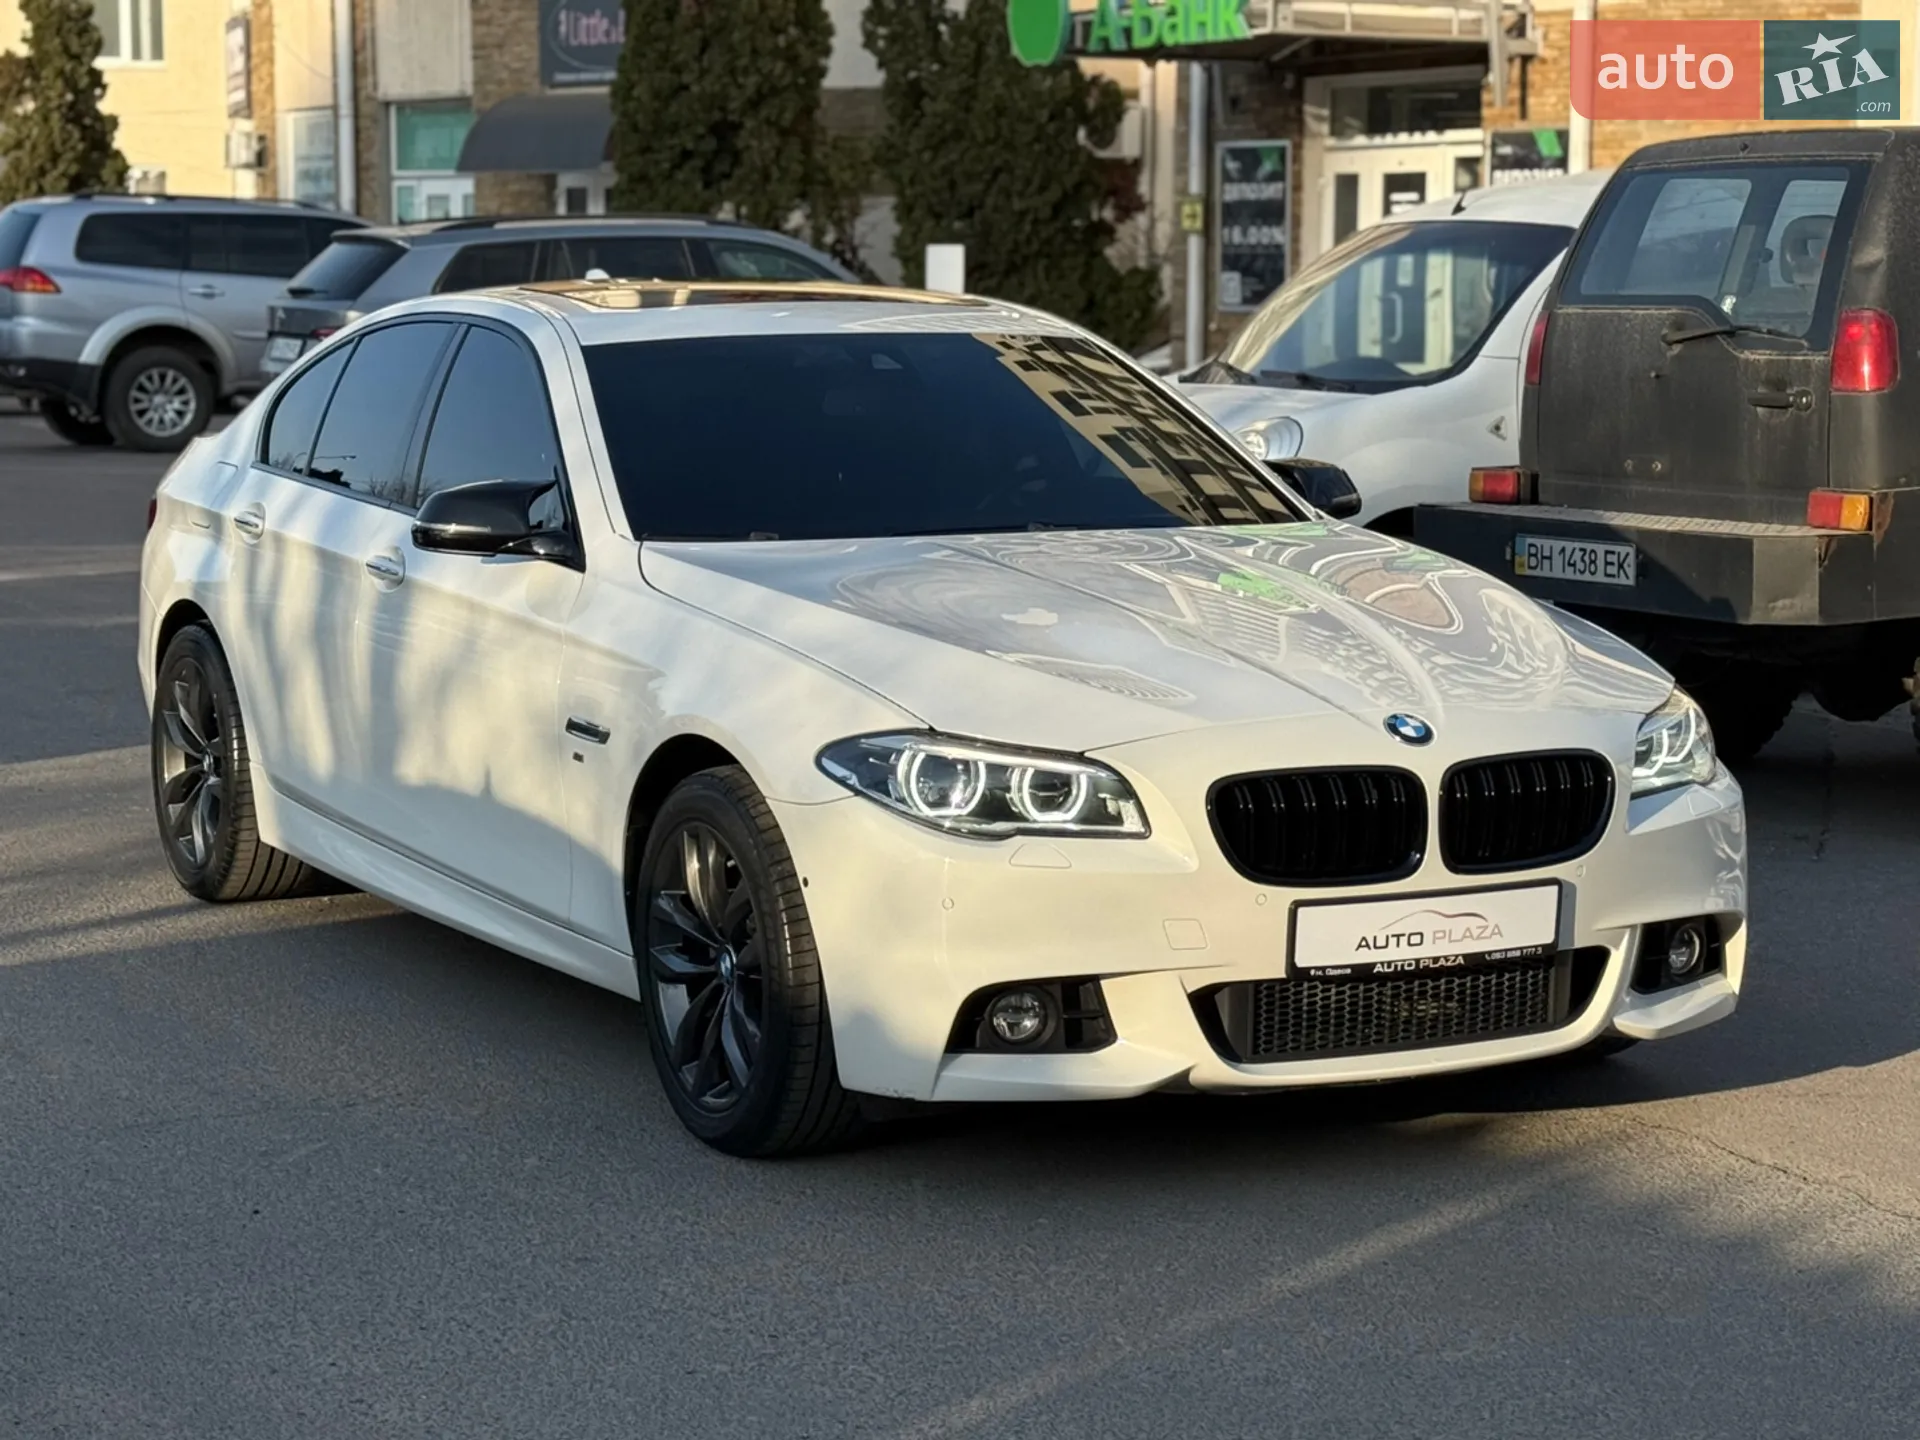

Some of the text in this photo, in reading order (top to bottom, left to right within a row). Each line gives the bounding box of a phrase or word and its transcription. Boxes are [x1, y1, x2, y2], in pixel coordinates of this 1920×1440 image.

[1527, 543, 1630, 580] BH 1438 EK
[1355, 924, 1504, 952] AUTO PLAZA
[1373, 955, 1465, 974] AUTO PLAZA
